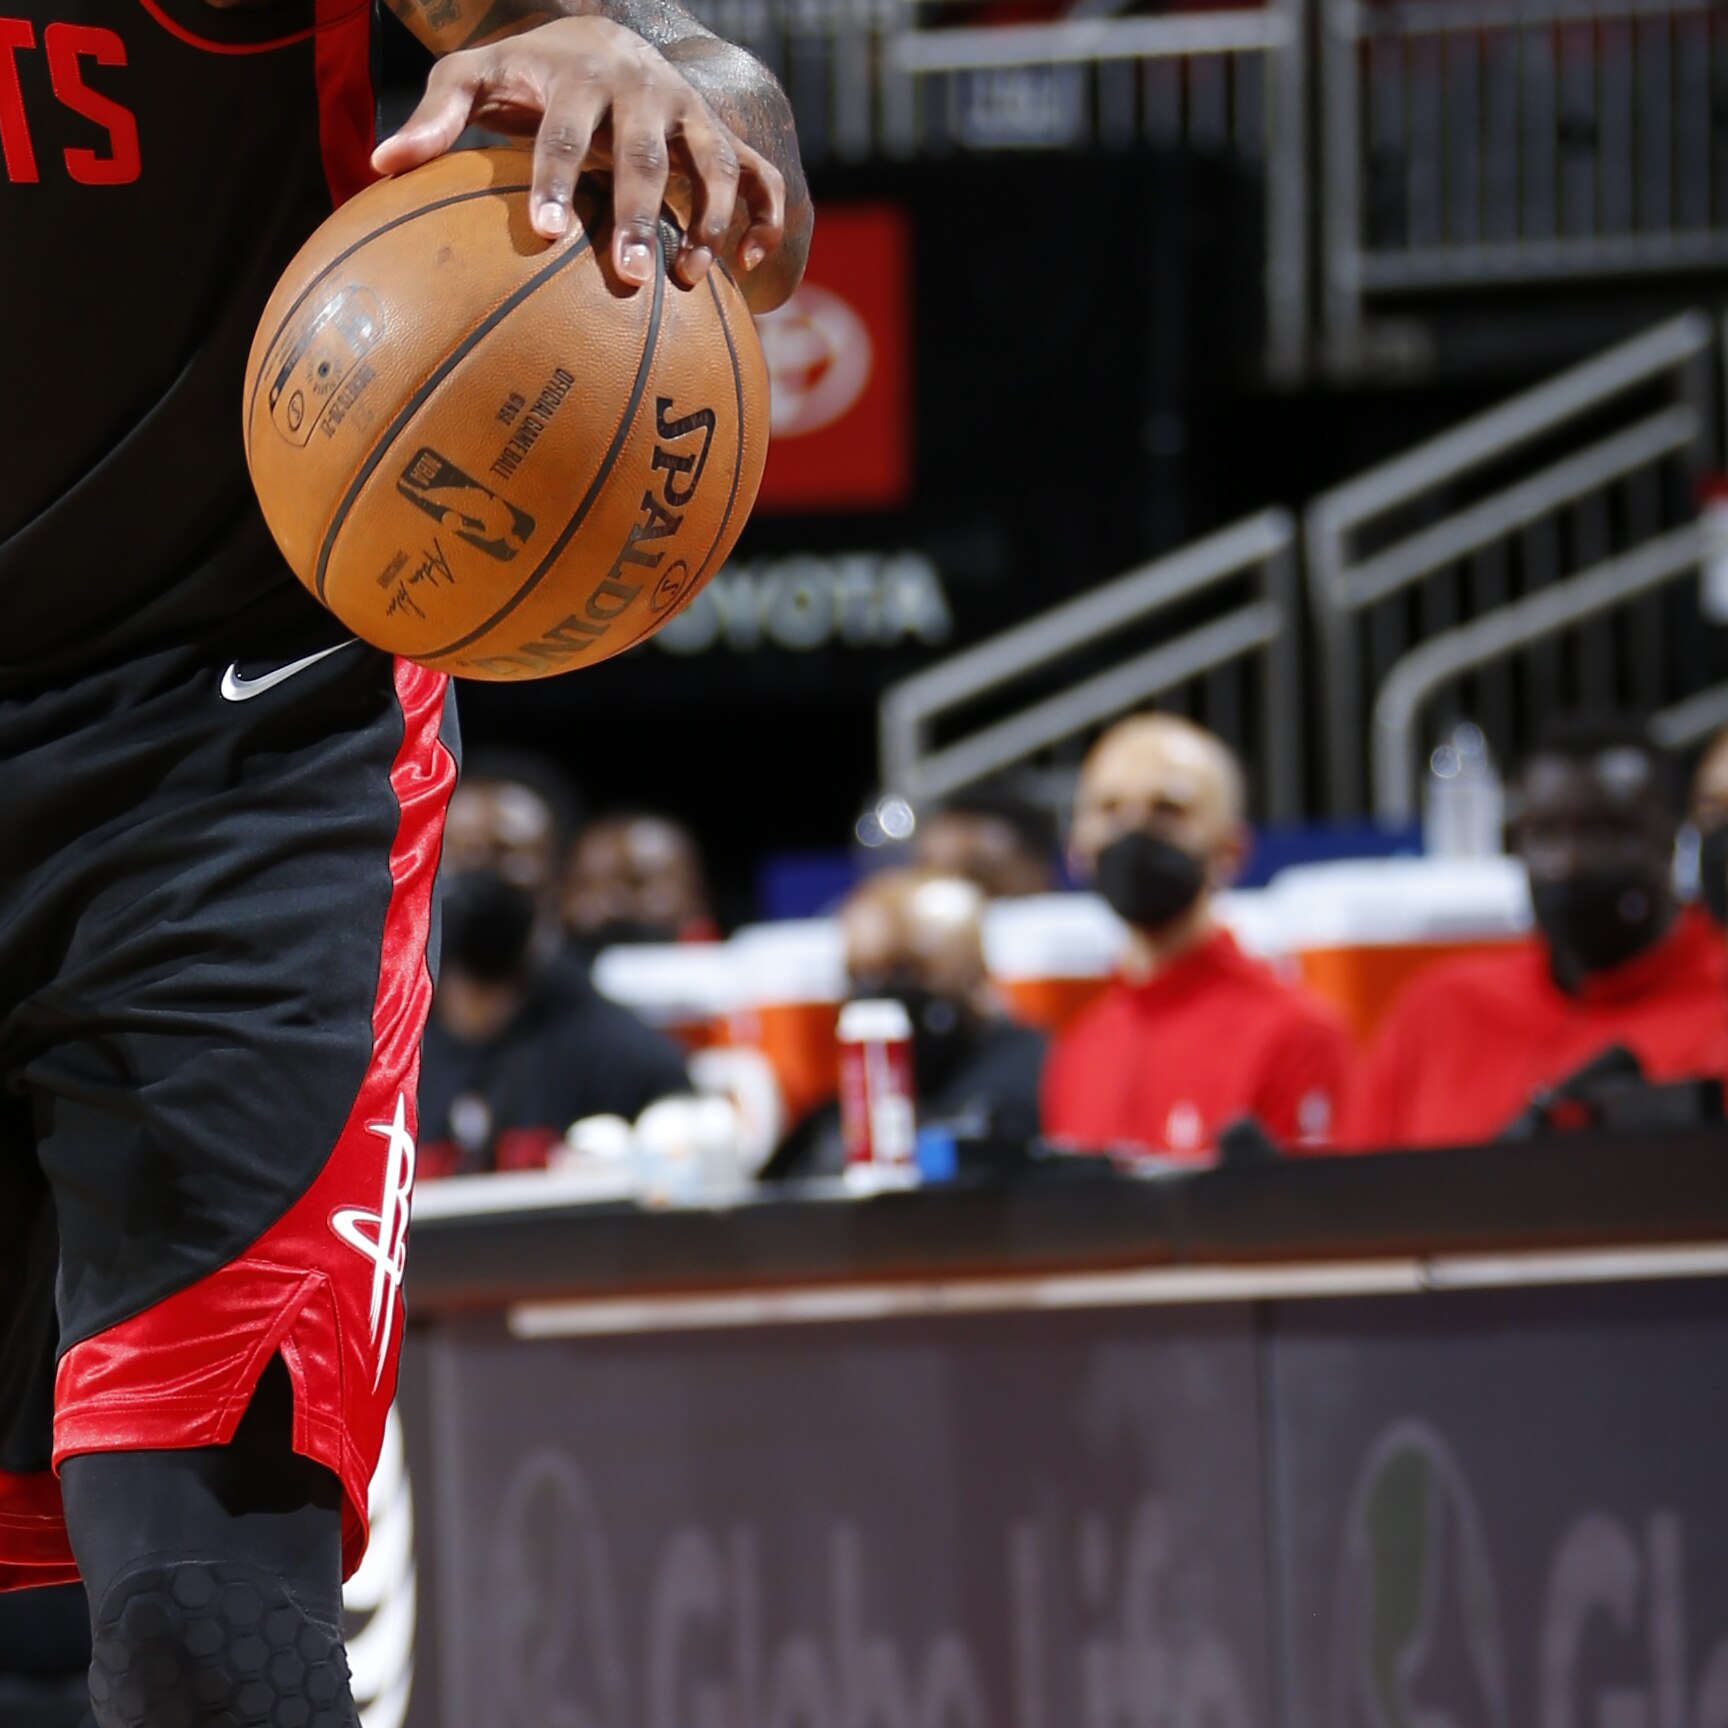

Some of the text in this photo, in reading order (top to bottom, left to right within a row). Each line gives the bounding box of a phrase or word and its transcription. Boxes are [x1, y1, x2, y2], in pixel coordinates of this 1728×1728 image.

[489, 367, 577, 482] OFFICIAL GAME BALL
[408, 451, 444, 488] NBA
